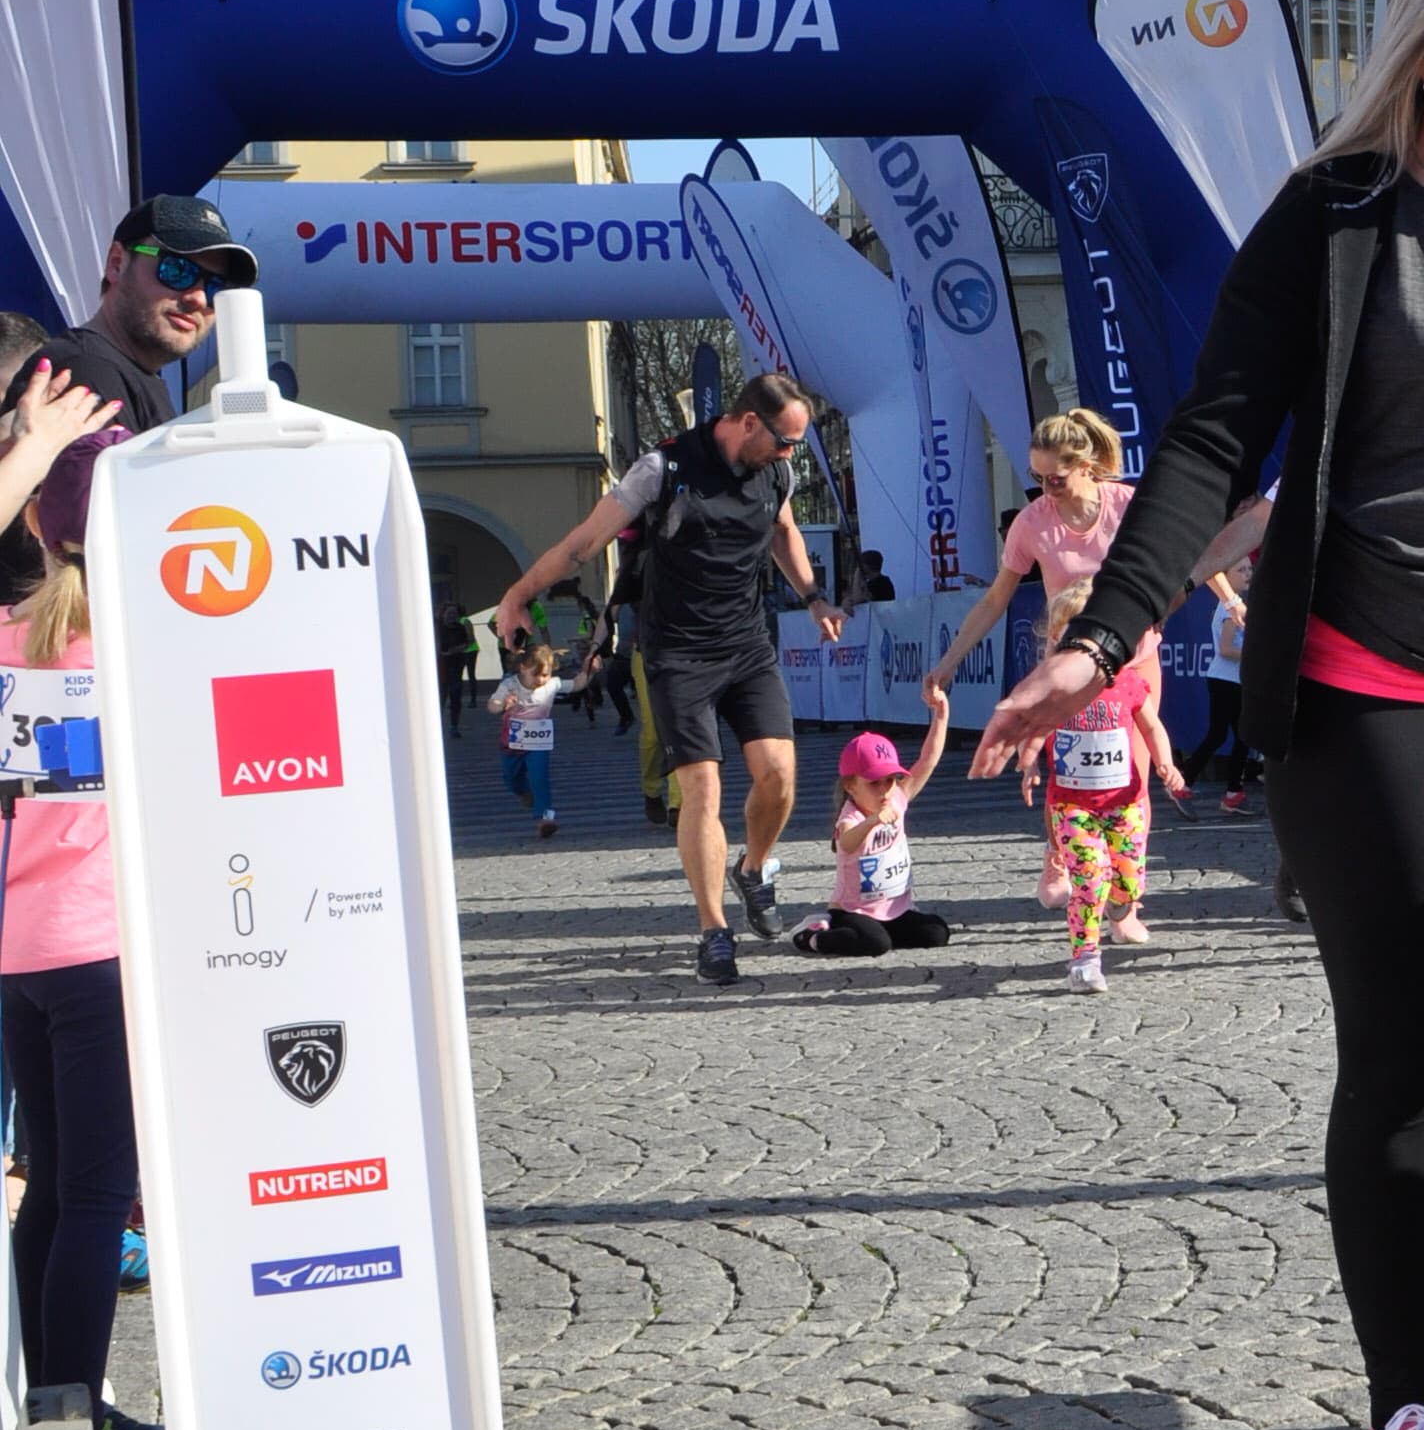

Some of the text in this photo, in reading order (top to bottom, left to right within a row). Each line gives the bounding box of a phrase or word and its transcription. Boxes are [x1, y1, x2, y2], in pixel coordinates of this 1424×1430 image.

[356, 219, 692, 265] INTERSPORT
[292, 533, 371, 572] NN
[1160, 642, 1214, 678] PEUG
[64, 675, 95, 686] KIDS
[64, 687, 91, 697] CUP
[523, 729, 552, 739] 3007
[1079, 749, 1124, 767] 3214
[232, 754, 329, 786] AVON
[327, 886, 383, 903] Powered
[328, 901, 384, 920] by MVM
[206, 945, 288, 971] innogy
[271, 1027, 339, 1042] PEUGEOT
[256, 1165, 382, 1198] NUTREND
[307, 1343, 411, 1380] ŠKODA
